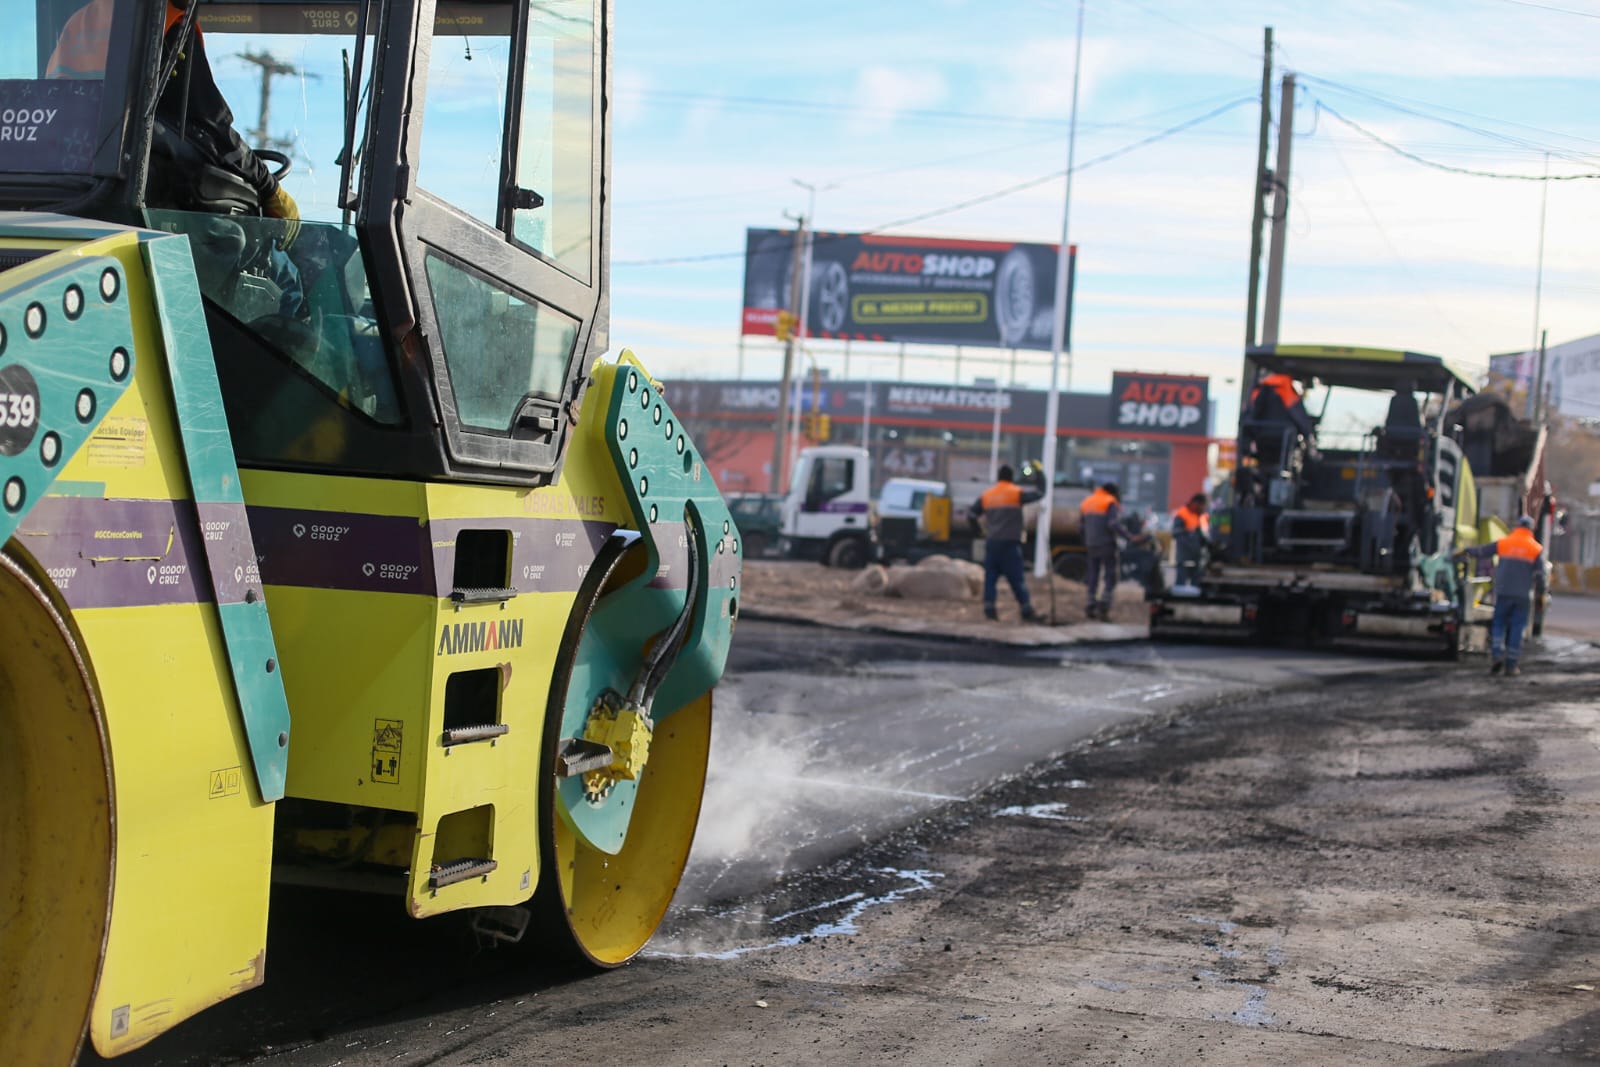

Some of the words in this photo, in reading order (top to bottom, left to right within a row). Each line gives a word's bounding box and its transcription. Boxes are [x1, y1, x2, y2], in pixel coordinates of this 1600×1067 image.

[2, 108, 58, 124] ODOY
[0, 126, 38, 141] RUZ
[851, 250, 996, 277] AUTOSHOP
[1120, 380, 1203, 405] AUTO
[1118, 402, 1201, 428] SHOP
[524, 493, 564, 513] OBRAS
[205, 521, 230, 532] GODOY
[311, 524, 350, 535] GODOY
[205, 531, 223, 541] CRUZ
[310, 533, 340, 541] CRUZ
[160, 565, 187, 575] GODOY
[380, 564, 419, 574] GODOY
[159, 574, 180, 585] CRUZ
[380, 572, 409, 580] CRUZ
[437, 618, 524, 656] AMMANN
